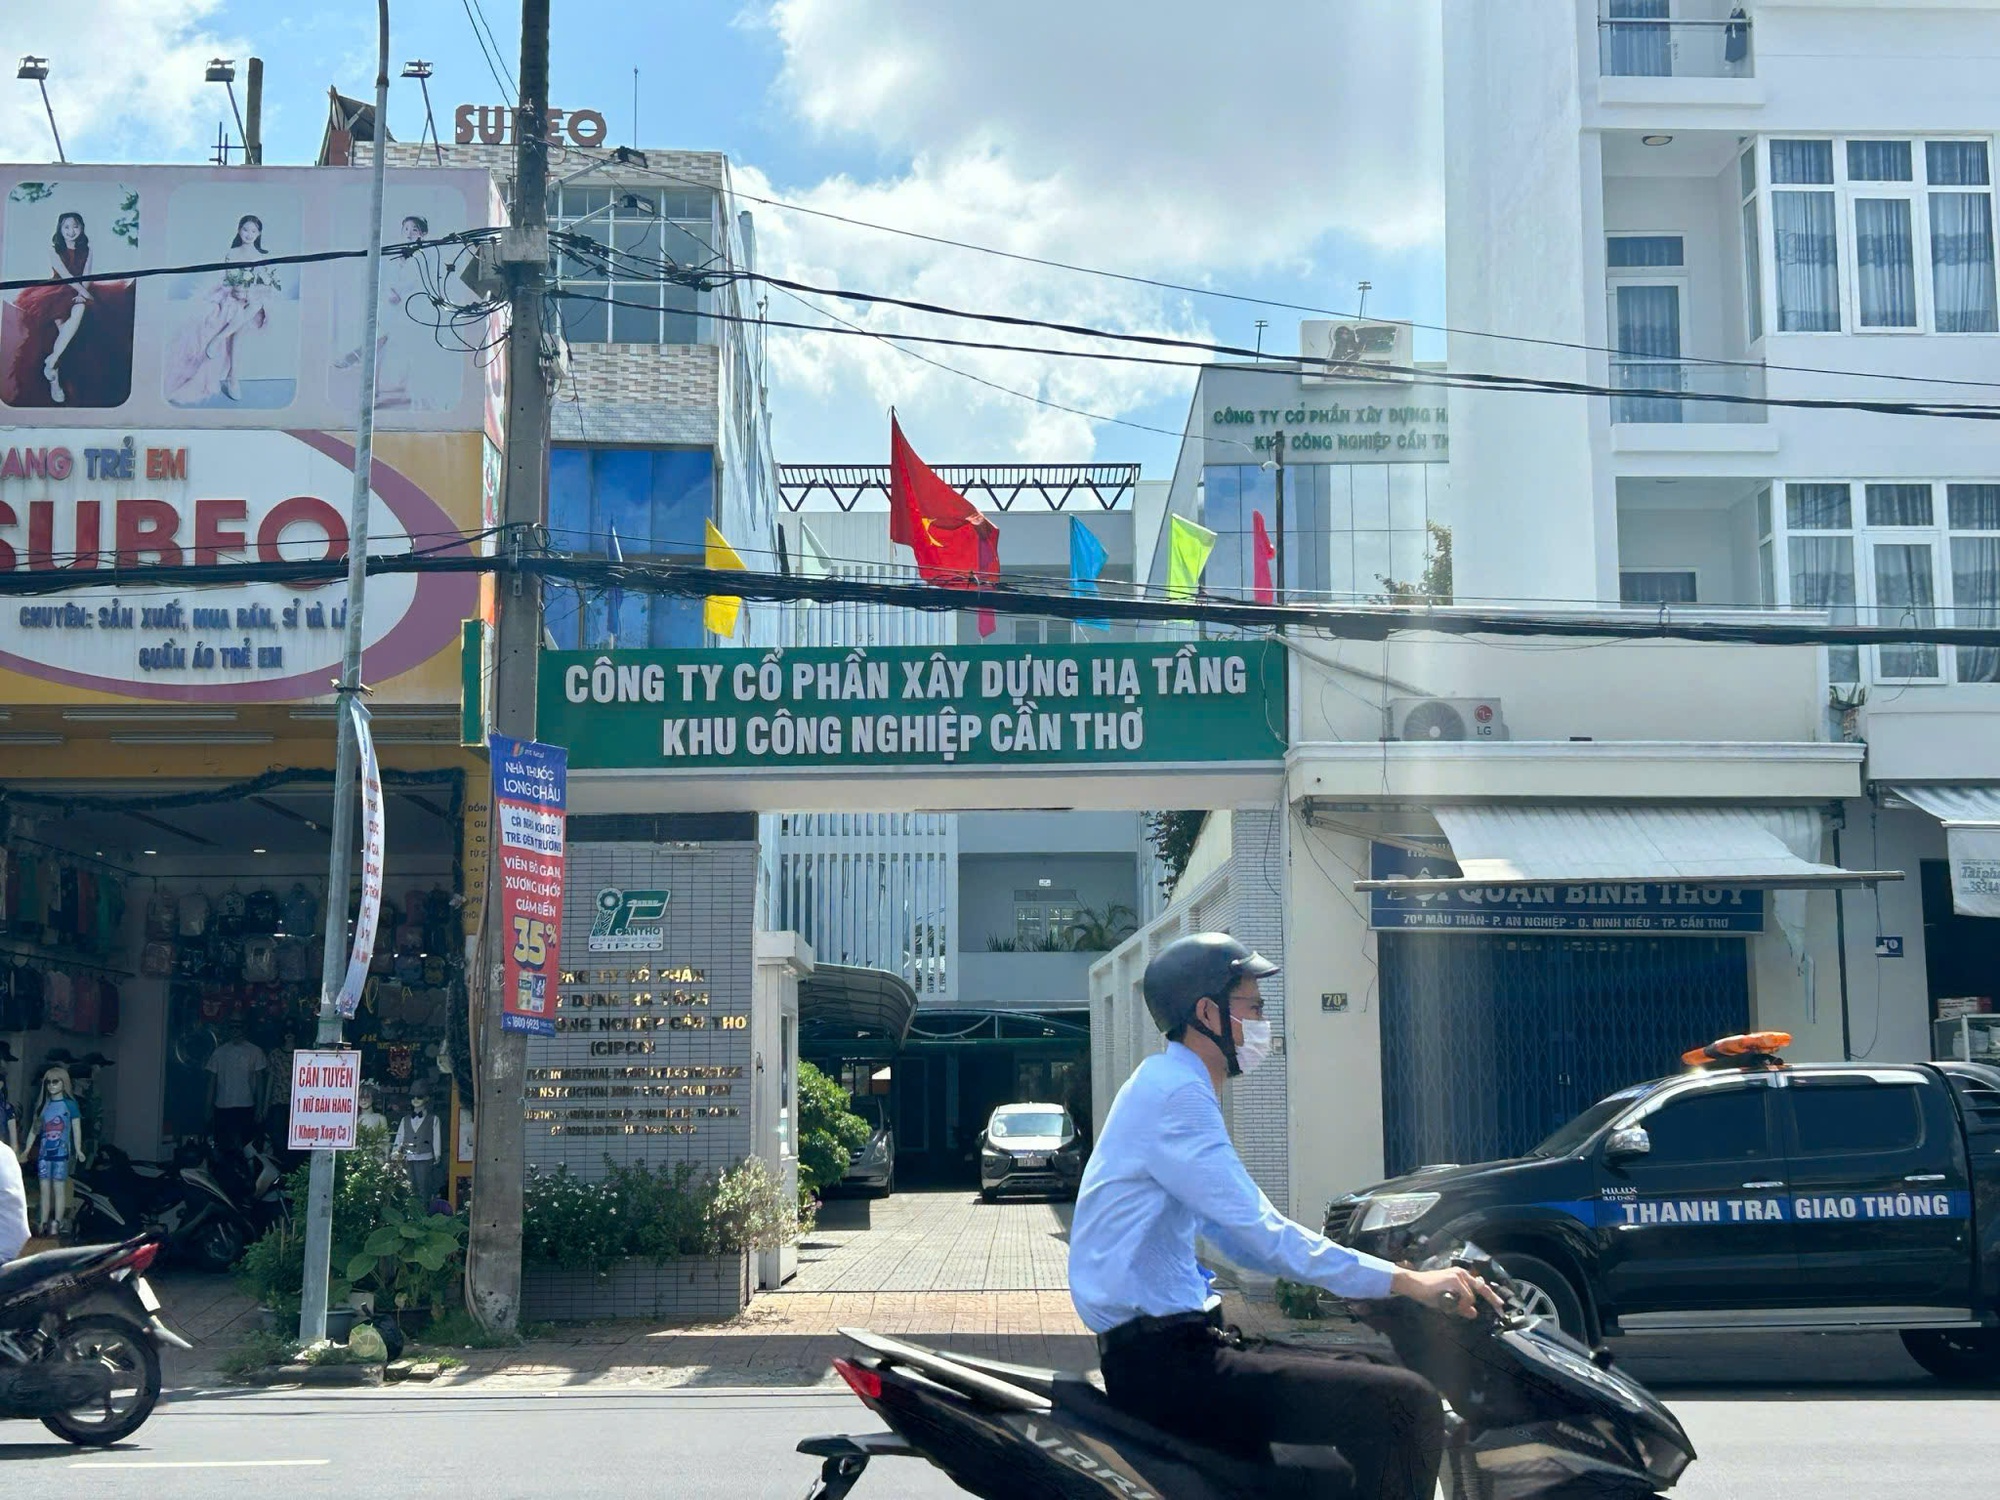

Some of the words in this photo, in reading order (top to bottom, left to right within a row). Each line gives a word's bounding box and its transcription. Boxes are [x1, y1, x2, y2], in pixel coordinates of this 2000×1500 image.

[1213, 406, 1255, 424] CÔNG
[1259, 410, 1279, 424] TY
[1355, 405, 1382, 424] XÂY
[1436, 407, 1448, 424] H
[1292, 432, 1333, 451] CÔNG
[0, 447, 73, 480] ANG
[84, 435, 135, 480] TRẺ
[146, 448, 188, 480] EM
[0, 496, 349, 590] UBEO
[98, 598, 133, 630] SẢN
[193, 607, 231, 630] MUA
[220, 637, 252, 670] TRẺ
[257, 646, 283, 669] EM
[565, 656, 665, 703] CÔNG
[677, 664, 723, 701] TY
[733, 644, 785, 701] CỔ
[792, 647, 889, 700] PHẦN
[901, 652, 970, 699] XÂY
[981, 654, 1079, 706] DỰNG
[1092, 659, 1141, 704] HẠ
[1152, 644, 1247, 694] TẦNG
[663, 717, 737, 756] KHU
[746, 708, 842, 755] CÔNG
[852, 705, 982, 761] NGHIỆP
[990, 701, 1061, 751] CẦN
[1070, 707, 1143, 750] THƠ
[1477, 726, 1492, 735] LG
[505, 761, 525, 775] NHÀ
[526, 764, 554, 781] THUỐC
[504, 777, 531, 797] LONG
[532, 783, 561, 802] CHÂU
[504, 855, 527, 871] VIÊN
[1493, 916, 1501, 926] P.
[1505, 916, 1521, 926] AN
[1593, 918, 1621, 928] NINH
[1662, 918, 1677, 928] TP.
[1708, 917, 1729, 928] THƠ
[591, 1039, 656, 1057] (CIPCO)
[297, 1098, 301, 1113] 1
[321, 1125, 336, 1142] Xoay
[338, 1126, 347, 1140] Ca
[1601, 1187, 1638, 1195] HILUX
[1622, 1202, 1721, 1224] THANH
[1727, 1199, 1783, 1221] TRA
[1795, 1197, 1856, 1219] GIAO
[1862, 1192, 1950, 1217] THÔNG
